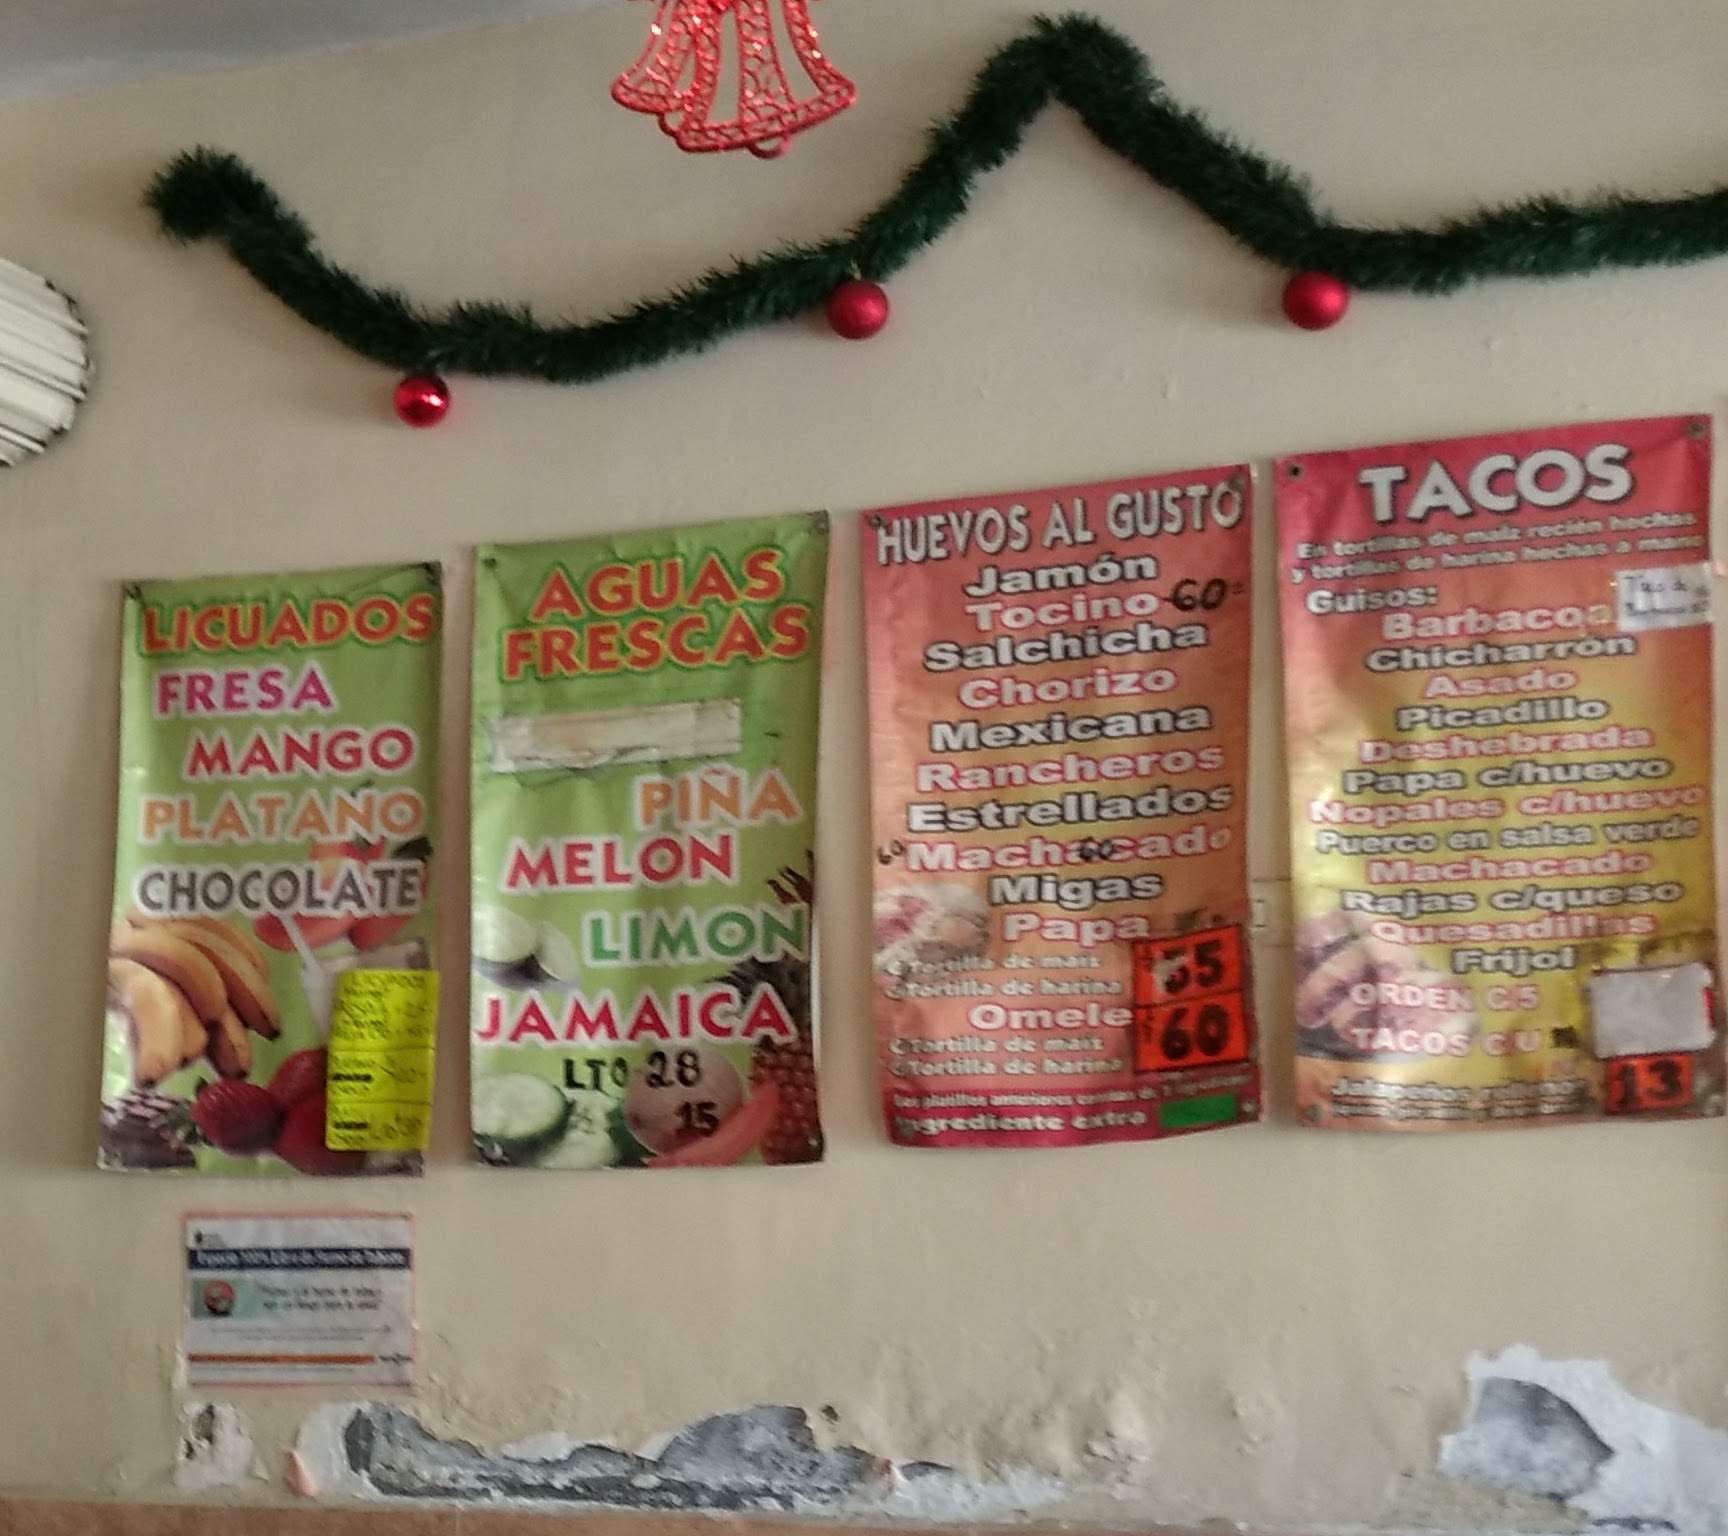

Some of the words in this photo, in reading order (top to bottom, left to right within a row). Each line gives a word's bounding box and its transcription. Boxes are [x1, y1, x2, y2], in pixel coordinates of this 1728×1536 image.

[1357, 442, 1635, 523] TACOS
[875, 503, 1031, 565] HUEVOS
[1041, 496, 1095, 548] AL
[1106, 480, 1243, 539] GUSTO
[528, 548, 786, 622] AGUAS
[964, 550, 1159, 598] Jamón
[141, 593, 436, 654] LICUADOS
[965, 591, 1160, 632] Tocino
[1305, 586, 1438, 616] Guisos:
[1382, 602, 1615, 641] Barbacoa
[502, 604, 810, 680] FRESCAS
[923, 621, 1208, 672] Salchicha
[156, 666, 334, 715] FRESA
[958, 667, 1178, 710] Chorizo
[1423, 669, 1579, 699] Asado
[929, 705, 1213, 753] Mexicana
[1395, 697, 1611, 732] Picadillo
[186, 727, 415, 778] MANGO
[1359, 725, 1654, 764] Deshebrada
[915, 744, 1225, 793] Rancheros
[1342, 767, 1467, 797] Papa
[1476, 757, 1674, 790] c/huevo
[141, 791, 425, 841] PLATANO
[639, 765, 801, 826] PIÑA
[906, 785, 1234, 833] Estrellados
[1308, 794, 1505, 826] Nopales
[1518, 784, 1706, 815] c/huevo
[1315, 828, 1438, 855] Puerco
[1447, 828, 1490, 851] en
[1498, 820, 1595, 848] salsa
[1602, 814, 1700, 844] verde
[506, 834, 733, 889] MELON
[1367, 850, 1654, 886] Machacado
[138, 865, 420, 912] CHOCOLATE
[989, 871, 1165, 912] Migas
[1340, 888, 1478, 918] Rajas
[1489, 880, 1686, 913] c/queso
[590, 908, 806, 962] LIMON
[1002, 911, 1152, 947] Papa
[1372, 913, 1659, 945] Quesadillas
[1450, 944, 1577, 977] Frijol
[477, 991, 791, 1044] JAMAICA
[966, 1001, 1135, 1032] Omele
[1348, 981, 1473, 1012] ORDEN
[1161, 1003, 1229, 1061] 60
[1350, 1026, 1473, 1057] TACOS
[645, 1048, 702, 1088] 28
[1614, 1057, 1684, 1108] 13
